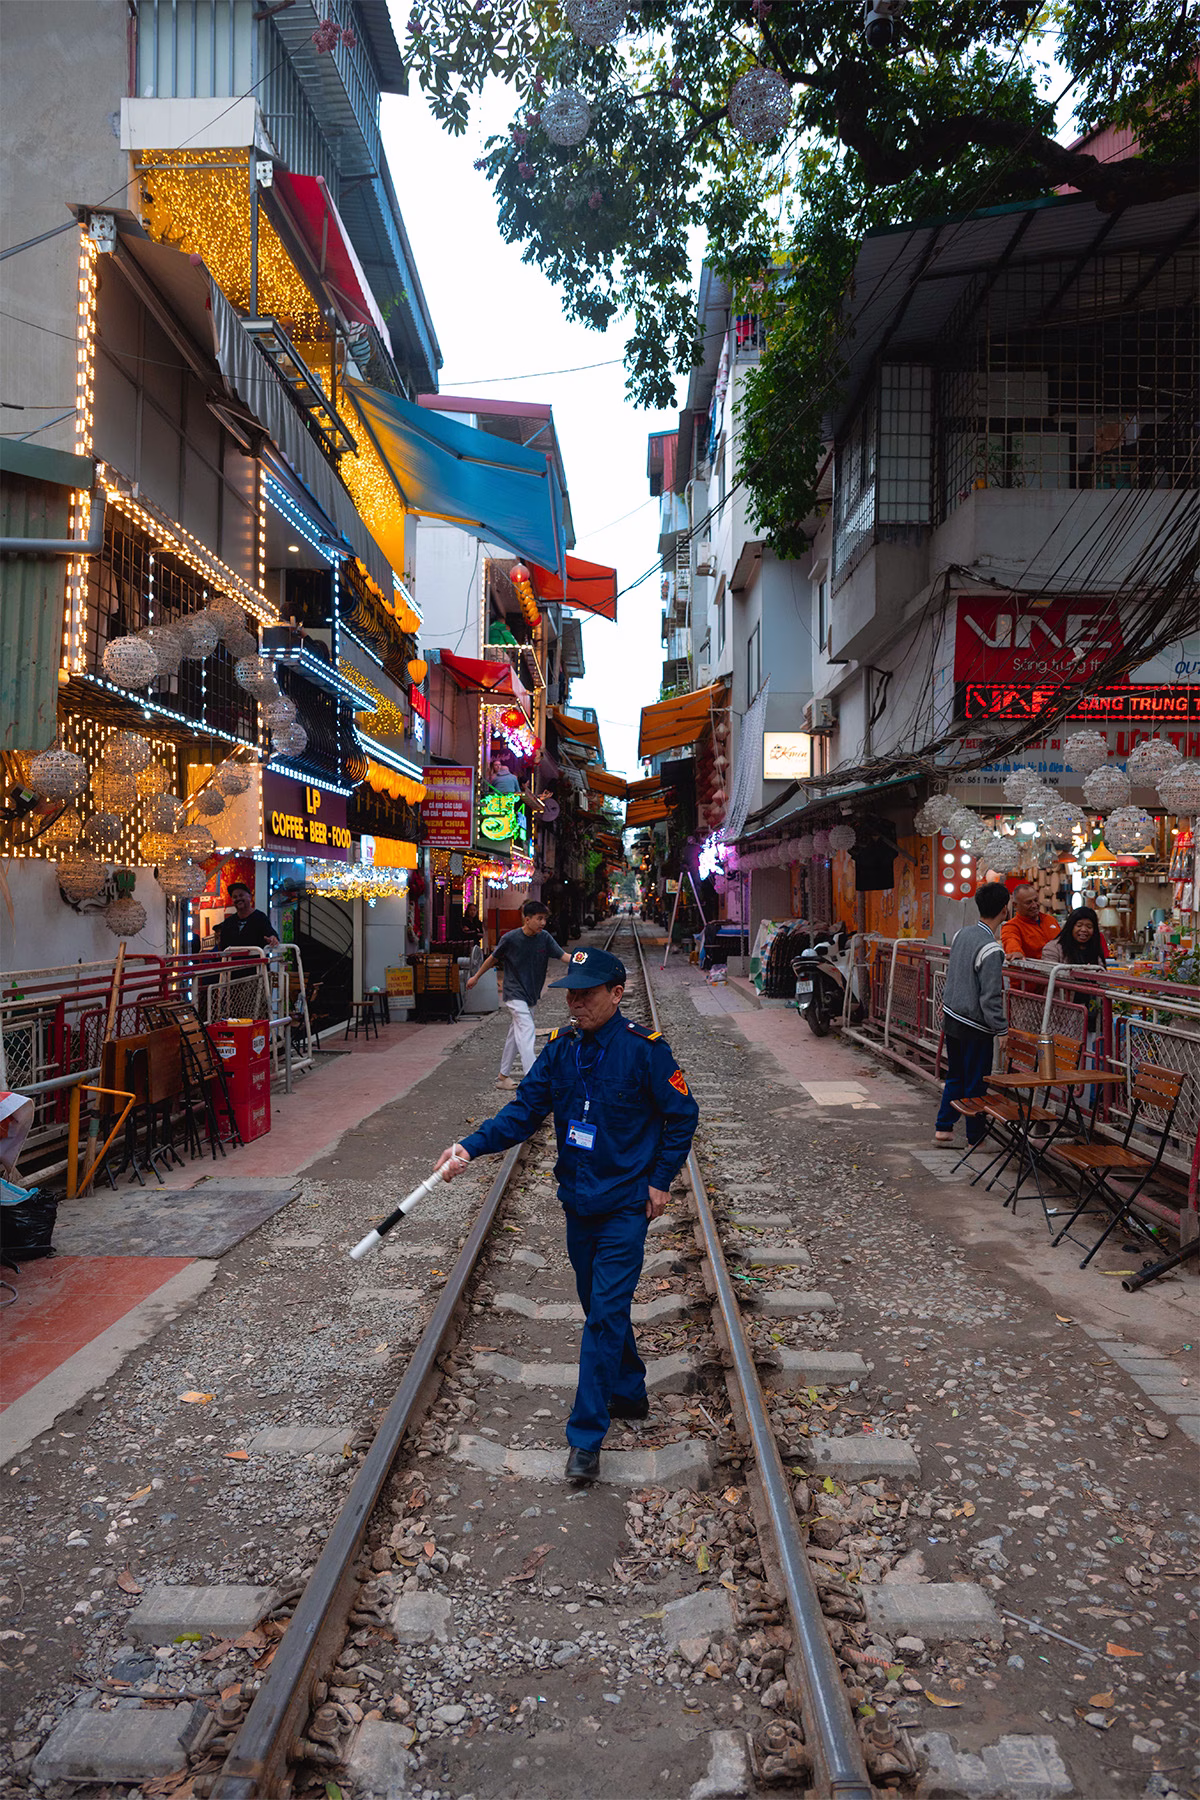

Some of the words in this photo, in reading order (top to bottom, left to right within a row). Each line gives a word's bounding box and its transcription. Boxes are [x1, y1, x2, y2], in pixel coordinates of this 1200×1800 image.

[1130, 697, 1189, 711] TRUNG
[305, 786, 321, 815] LP
[271, 810, 305, 840] COFFEE
[309, 820, 328, 845] BEER
[331, 825, 352, 849] FOOD
